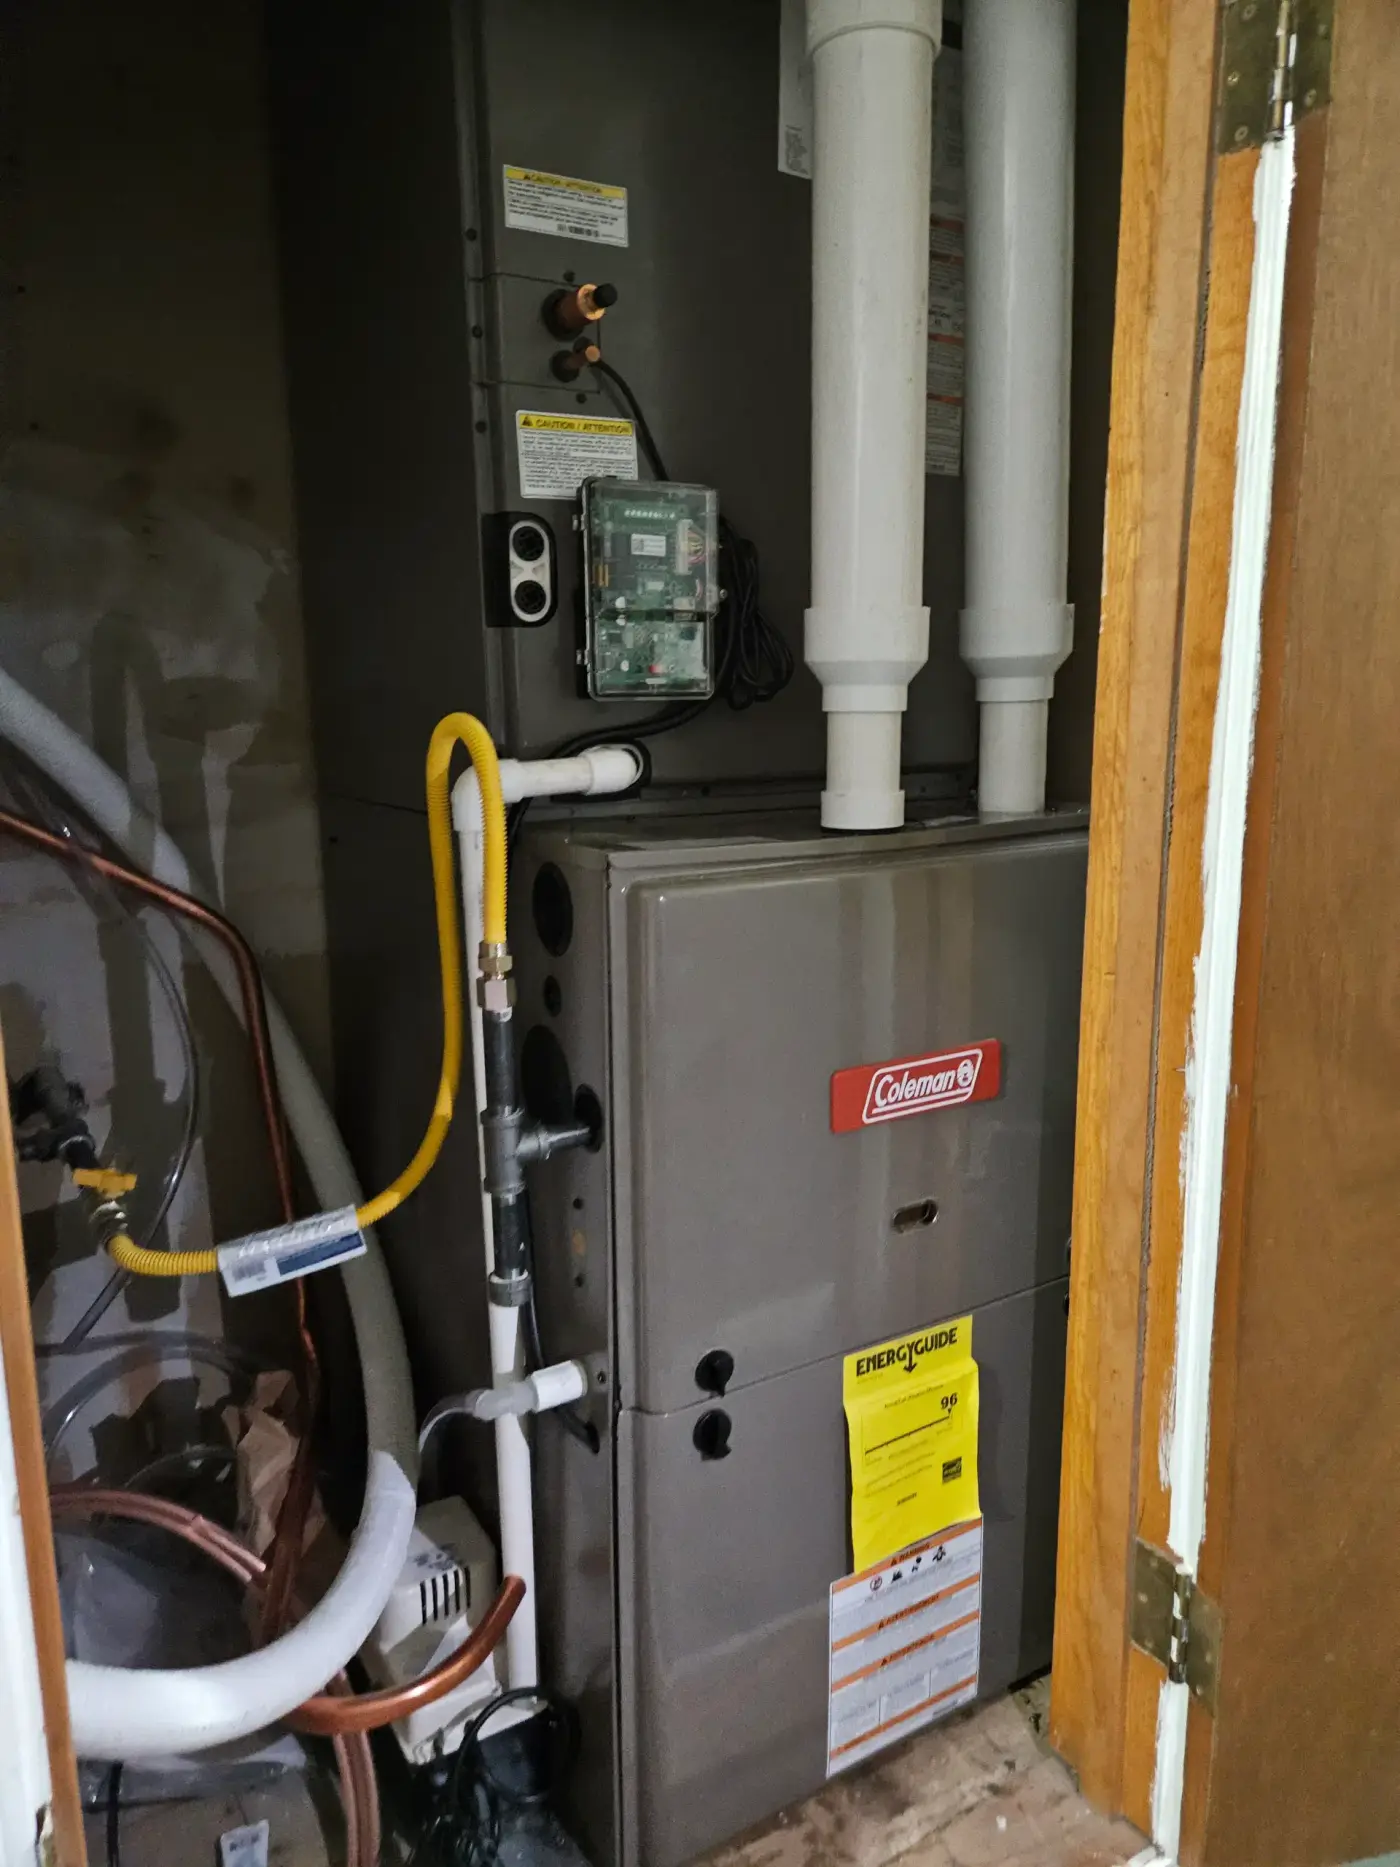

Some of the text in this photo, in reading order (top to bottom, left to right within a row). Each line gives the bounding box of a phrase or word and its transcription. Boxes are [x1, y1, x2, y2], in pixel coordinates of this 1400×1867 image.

[535, 418, 575, 429] CAUTION
[583, 422, 630, 434] ATTENTION
[875, 1070, 955, 1108] Coleman
[856, 1327, 958, 1377] ENERGYGUIDE
[941, 1392, 959, 1410] 96
